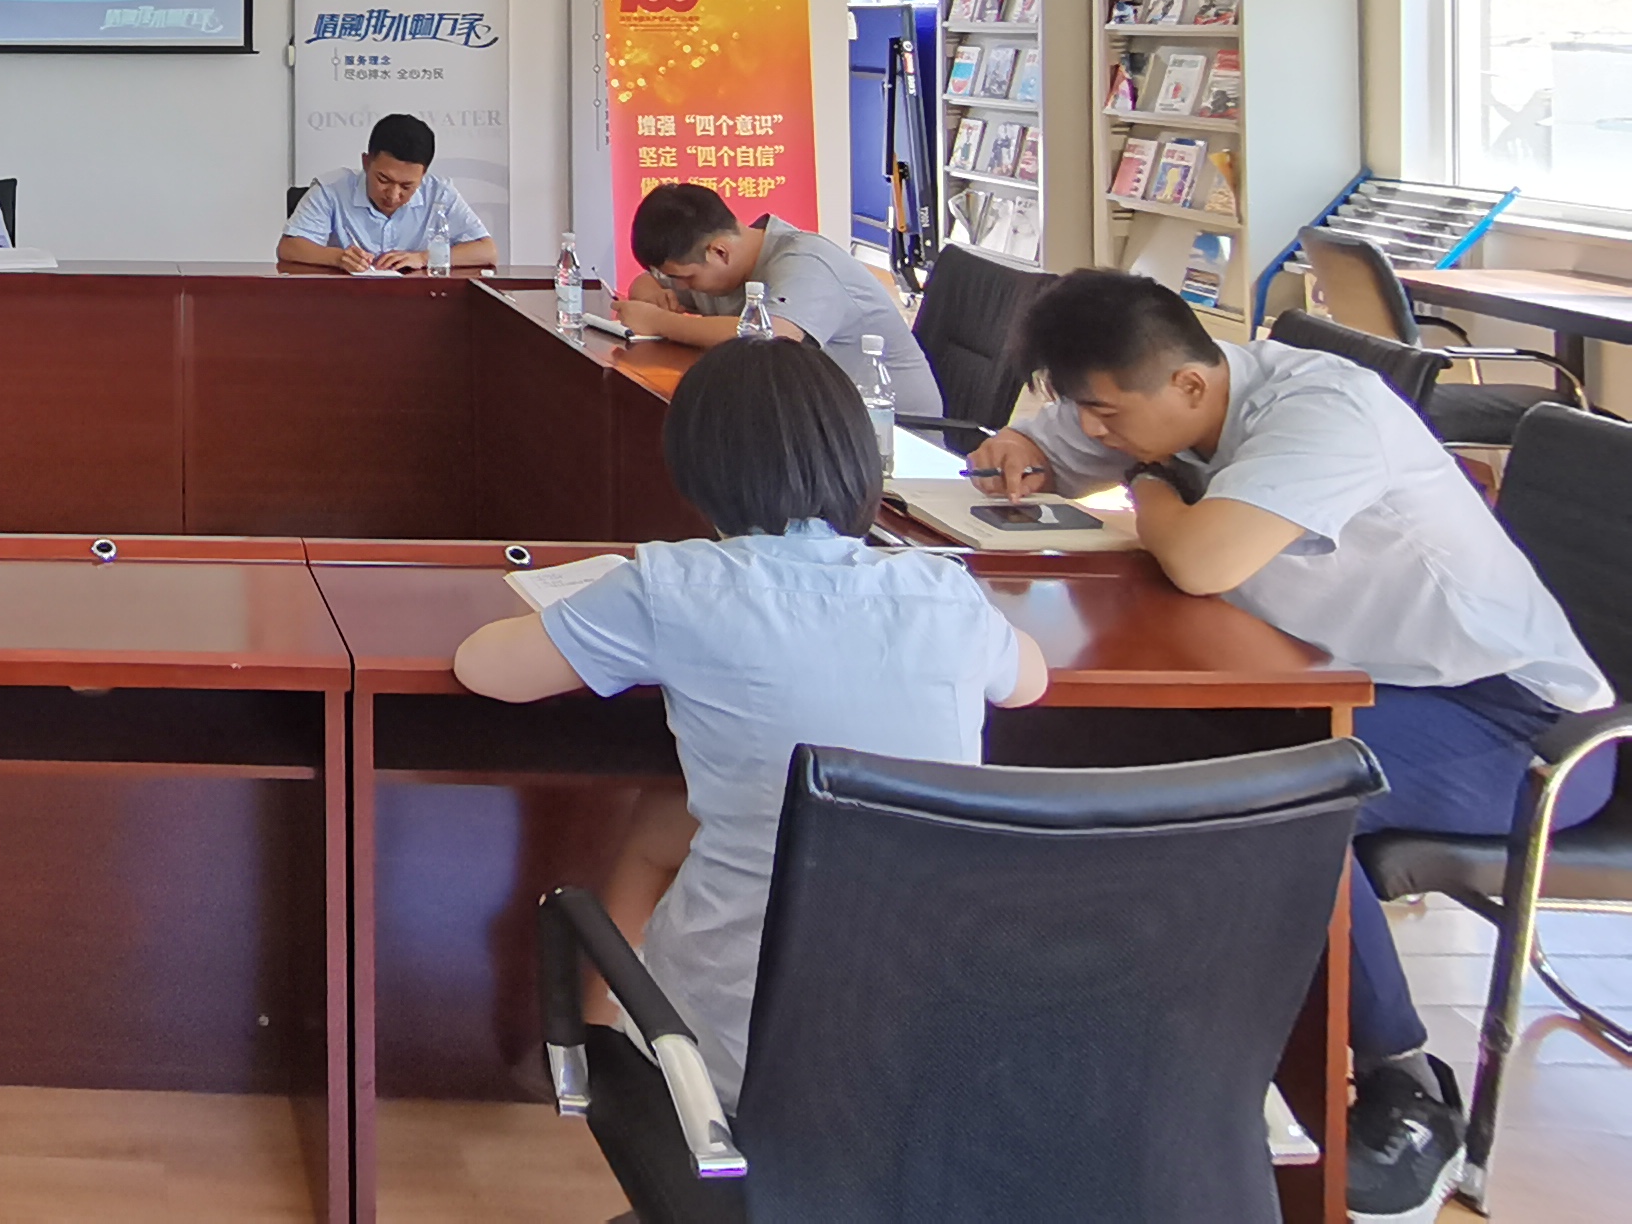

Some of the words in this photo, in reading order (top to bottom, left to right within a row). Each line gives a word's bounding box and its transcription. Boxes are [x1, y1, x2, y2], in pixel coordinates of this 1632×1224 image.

[343, 54, 392, 66] 服务理念
[343, 68, 392, 81] 尽心排水
[396, 68, 445, 81] 全心为民
